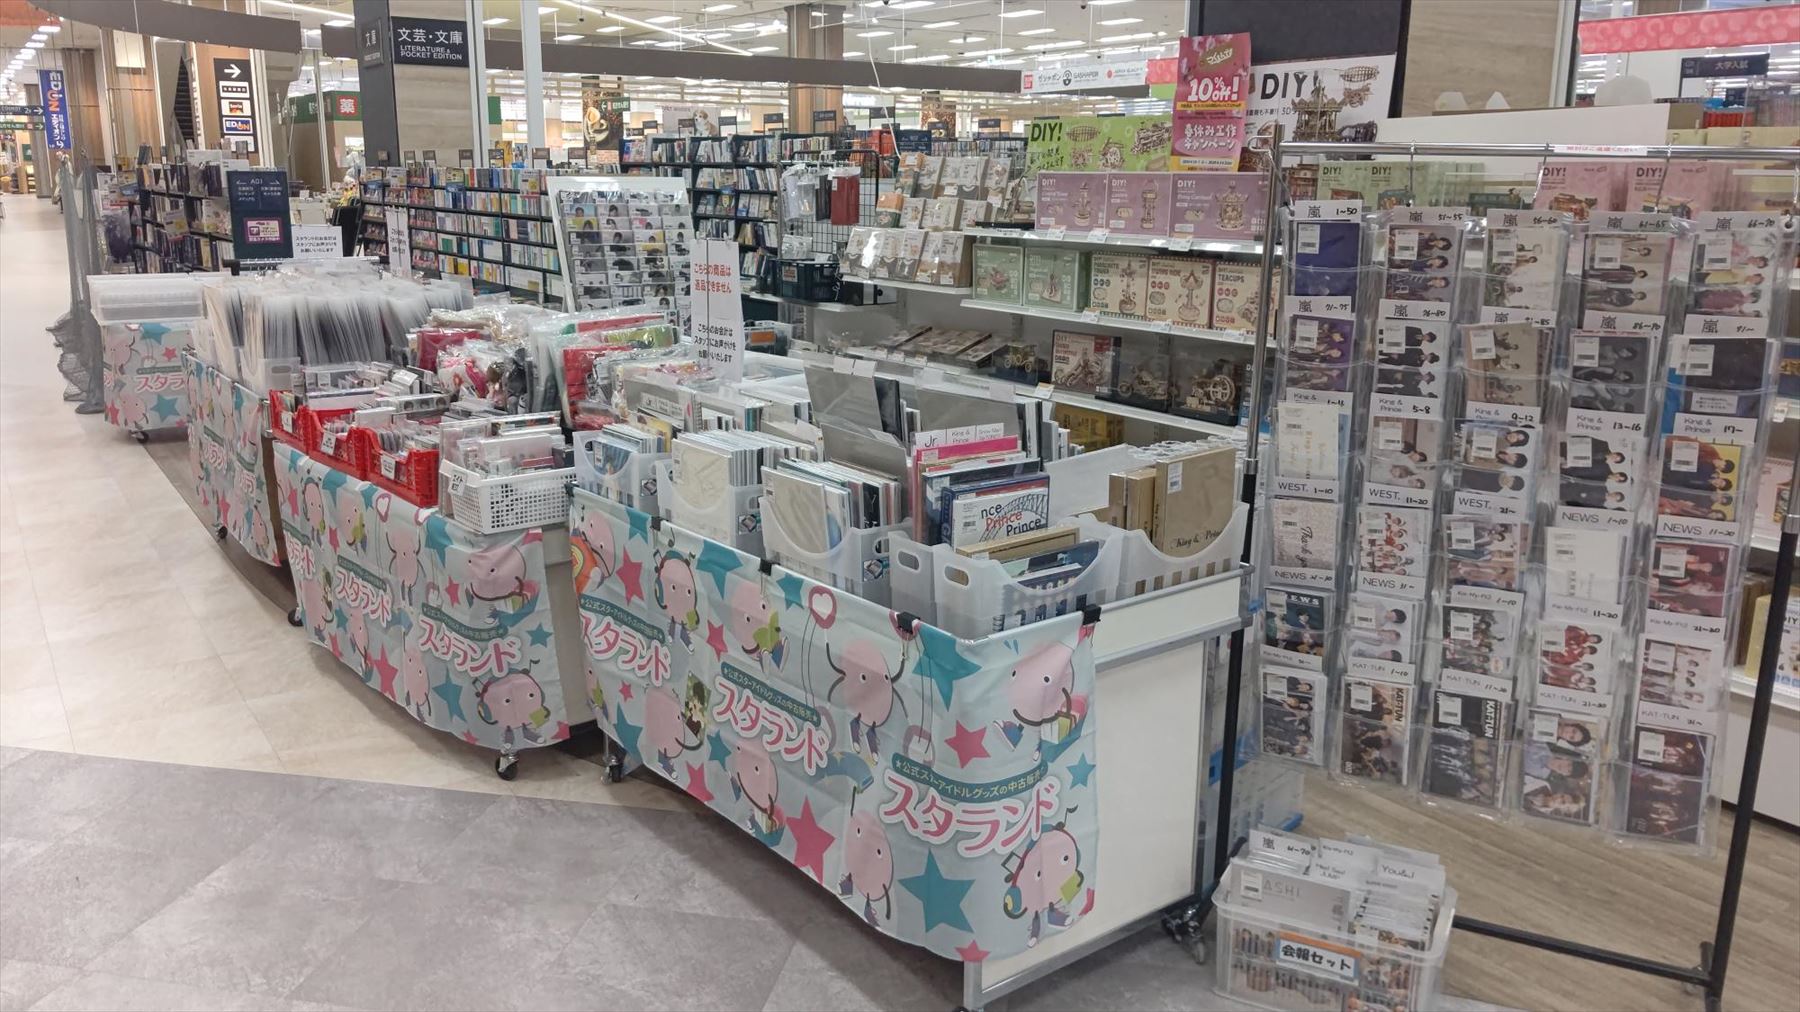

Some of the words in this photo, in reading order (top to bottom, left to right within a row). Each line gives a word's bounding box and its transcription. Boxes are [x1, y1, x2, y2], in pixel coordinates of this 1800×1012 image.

[397, 27, 464, 46] 文芸・文庫
[400, 45, 444, 53] LITERATURE
[433, 52, 463, 60] EDITION
[1030, 122, 1063, 142] DIY!
[1184, 123, 1238, 137] 春休み工作
[1184, 138, 1236, 151] キャンペーン
[1322, 166, 1342, 175] DIY!
[1371, 166, 1392, 175] DIY!
[1542, 167, 1567, 177] DIY!
[1636, 167, 1663, 177] DIY!
[1111, 179, 1127, 187] DIY!
[1177, 179, 1196, 188] DIY!
[1308, 205, 1321, 218] 嵐
[1409, 211, 1423, 222] 嵐
[1503, 214, 1518, 227] 嵐
[1607, 217, 1623, 229] 嵐
[1716, 217, 1732, 230] 嵐
[694, 263, 732, 278] こちらの商品は
[1217, 274, 1245, 283] TEACUPS
[1299, 300, 1312, 313] 嵐
[1394, 304, 1408, 317] 嵐
[1601, 316, 1616, 330] 嵐
[1702, 320, 1718, 333] 嵐
[698, 323, 733, 338] こちらのお会計は
[136, 374, 188, 392] スタラ
[1576, 414, 1594, 423] King
[1577, 422, 1602, 431] Prince
[1278, 482, 1310, 493] WEST.
[1369, 489, 1401, 500] WEST.
[1458, 497, 1492, 510] WEST.
[985, 511, 1023, 531] Prince
[1561, 512, 1599, 524] NEWS
[1006, 517, 1042, 537] Prince
[1663, 522, 1702, 536] NEWS
[1274, 570, 1307, 580] NEWS
[1362, 577, 1396, 589] NEWS
[336, 568, 391, 626] スタランド
[1289, 594, 1320, 606] EWS
[419, 616, 519, 675] スタランド
[580, 612, 671, 684] スタランド
[1395, 688, 1404, 722] KAT-TUN
[714, 677, 829, 773] スタランド
[1484, 700, 1496, 739] KAT-TUN
[881, 771, 1059, 856] スタランド
[1262, 836, 1275, 850] 嵐
[1263, 880, 1300, 898] ASHI
[1280, 943, 1352, 972] 会報セット
